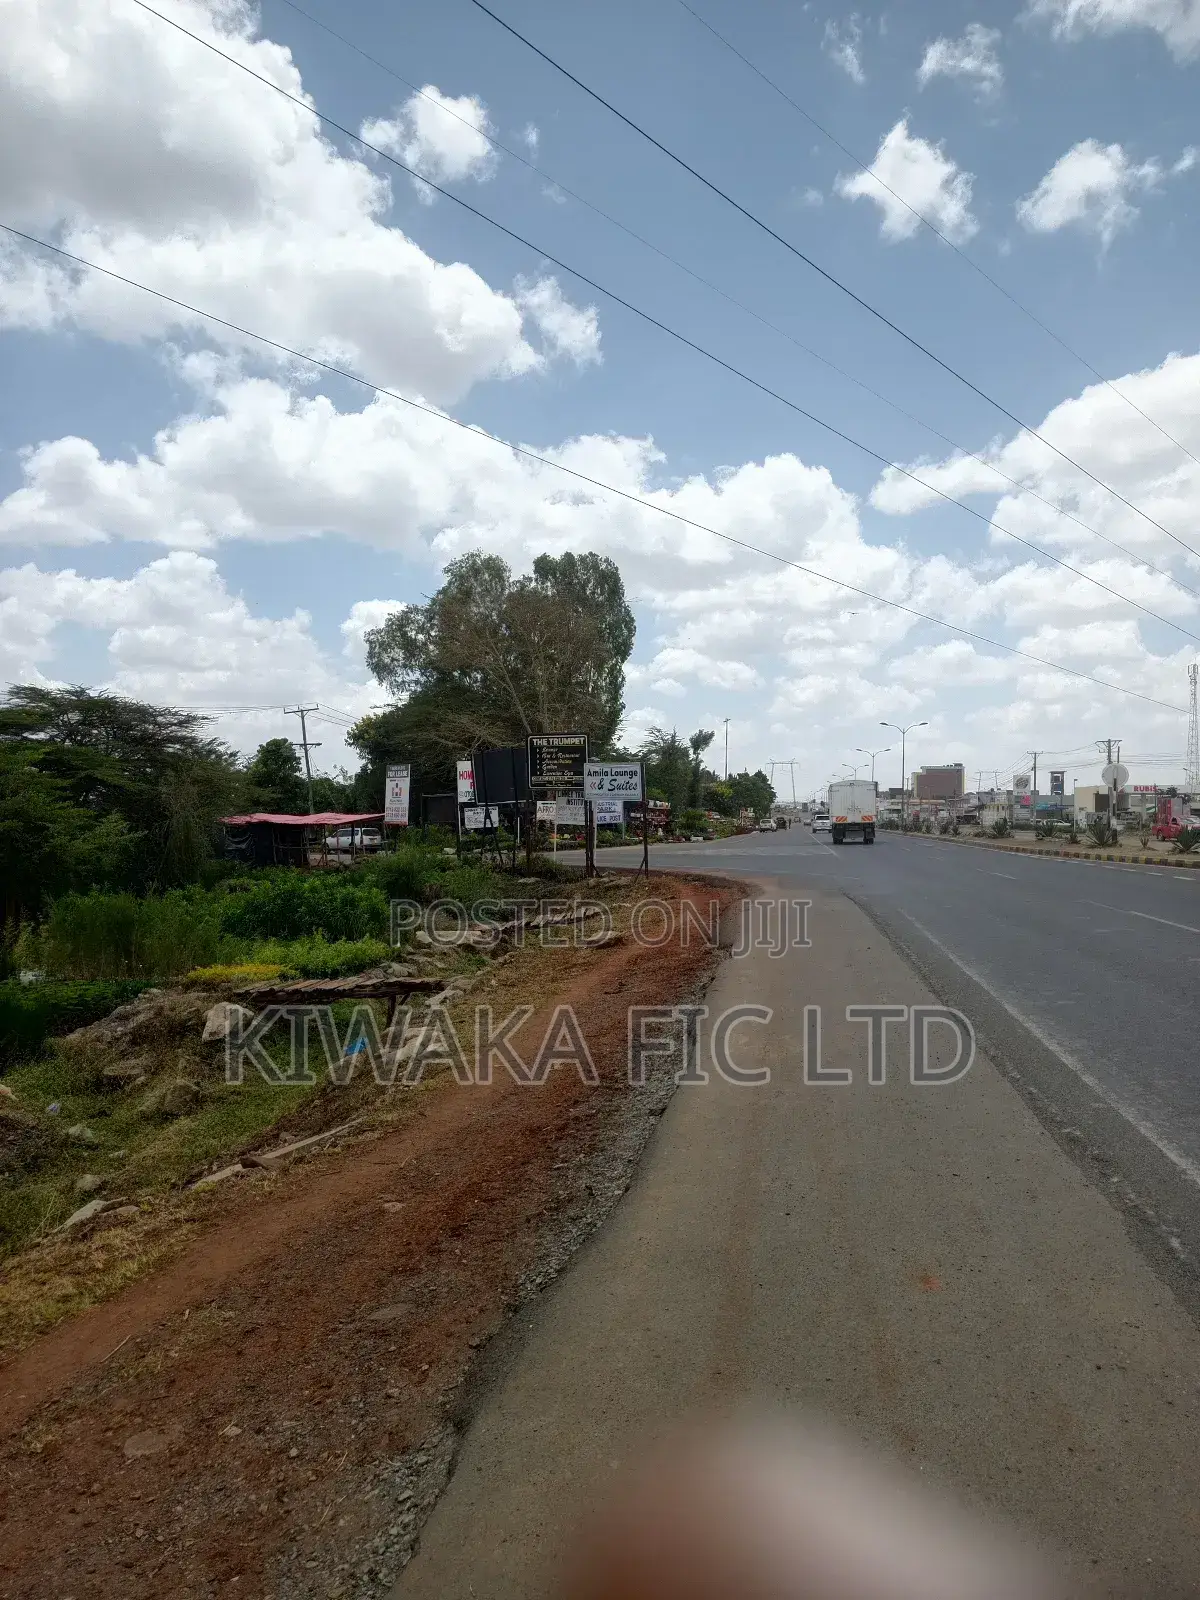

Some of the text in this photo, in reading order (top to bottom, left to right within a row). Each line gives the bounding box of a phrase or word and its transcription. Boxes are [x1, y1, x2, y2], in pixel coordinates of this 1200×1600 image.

[533, 738, 585, 746] THE TRUMPET
[587, 768, 638, 779] Amila Lounge
[597, 778, 604, 790] &
[608, 779, 638, 791] Suites
